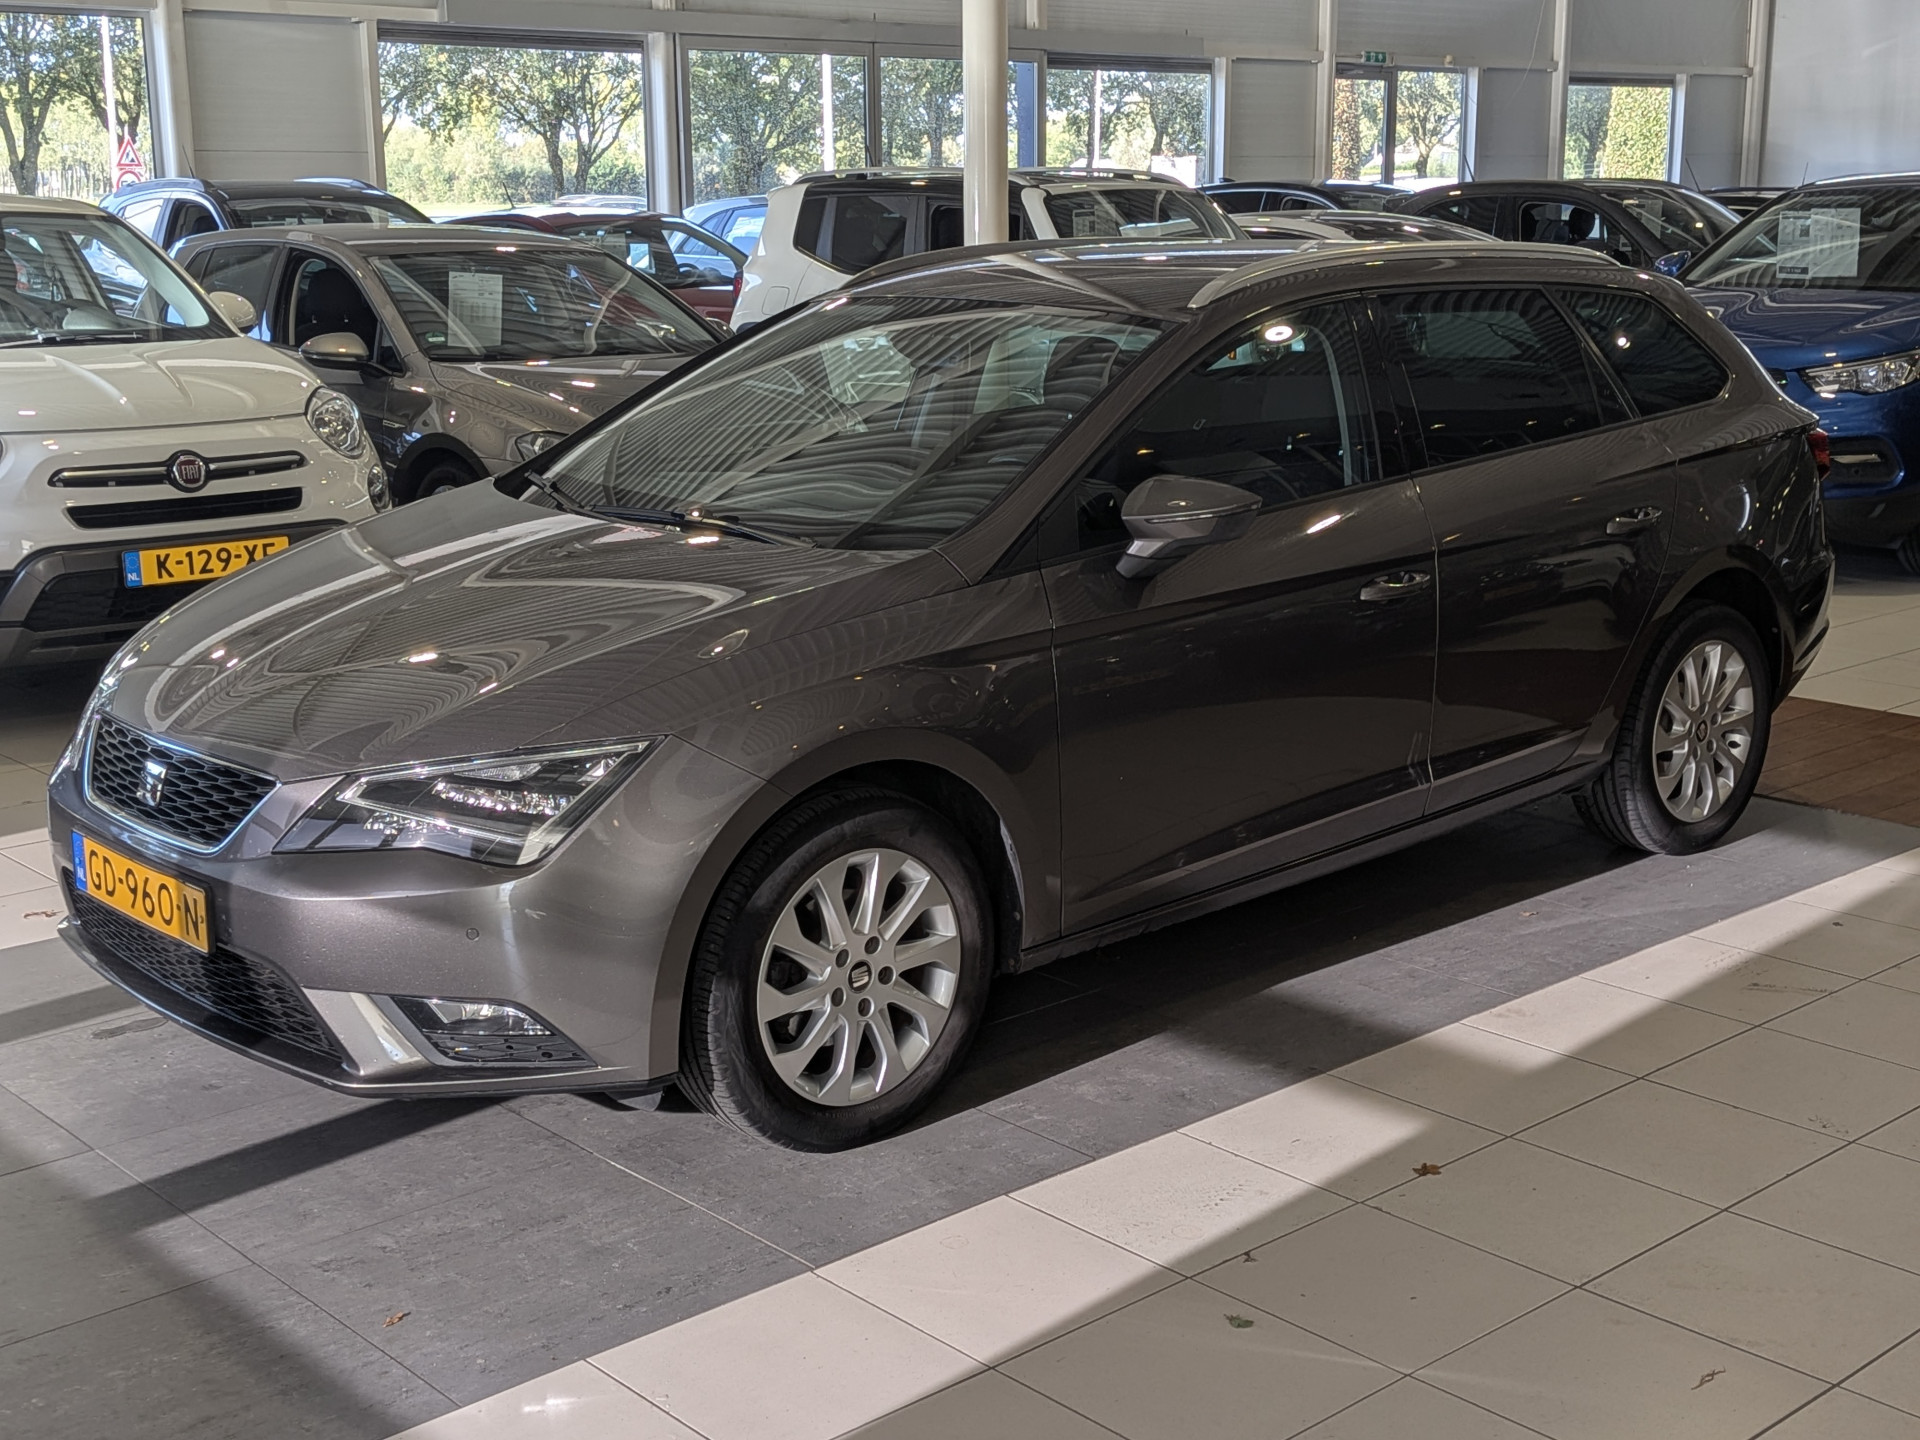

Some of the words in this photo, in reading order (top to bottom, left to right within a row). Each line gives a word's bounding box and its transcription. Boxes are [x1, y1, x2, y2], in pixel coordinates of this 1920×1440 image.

[181, 464, 199, 480] FIAT
[127, 572, 141, 581] NL
[89, 849, 200, 940] GD-960-N
